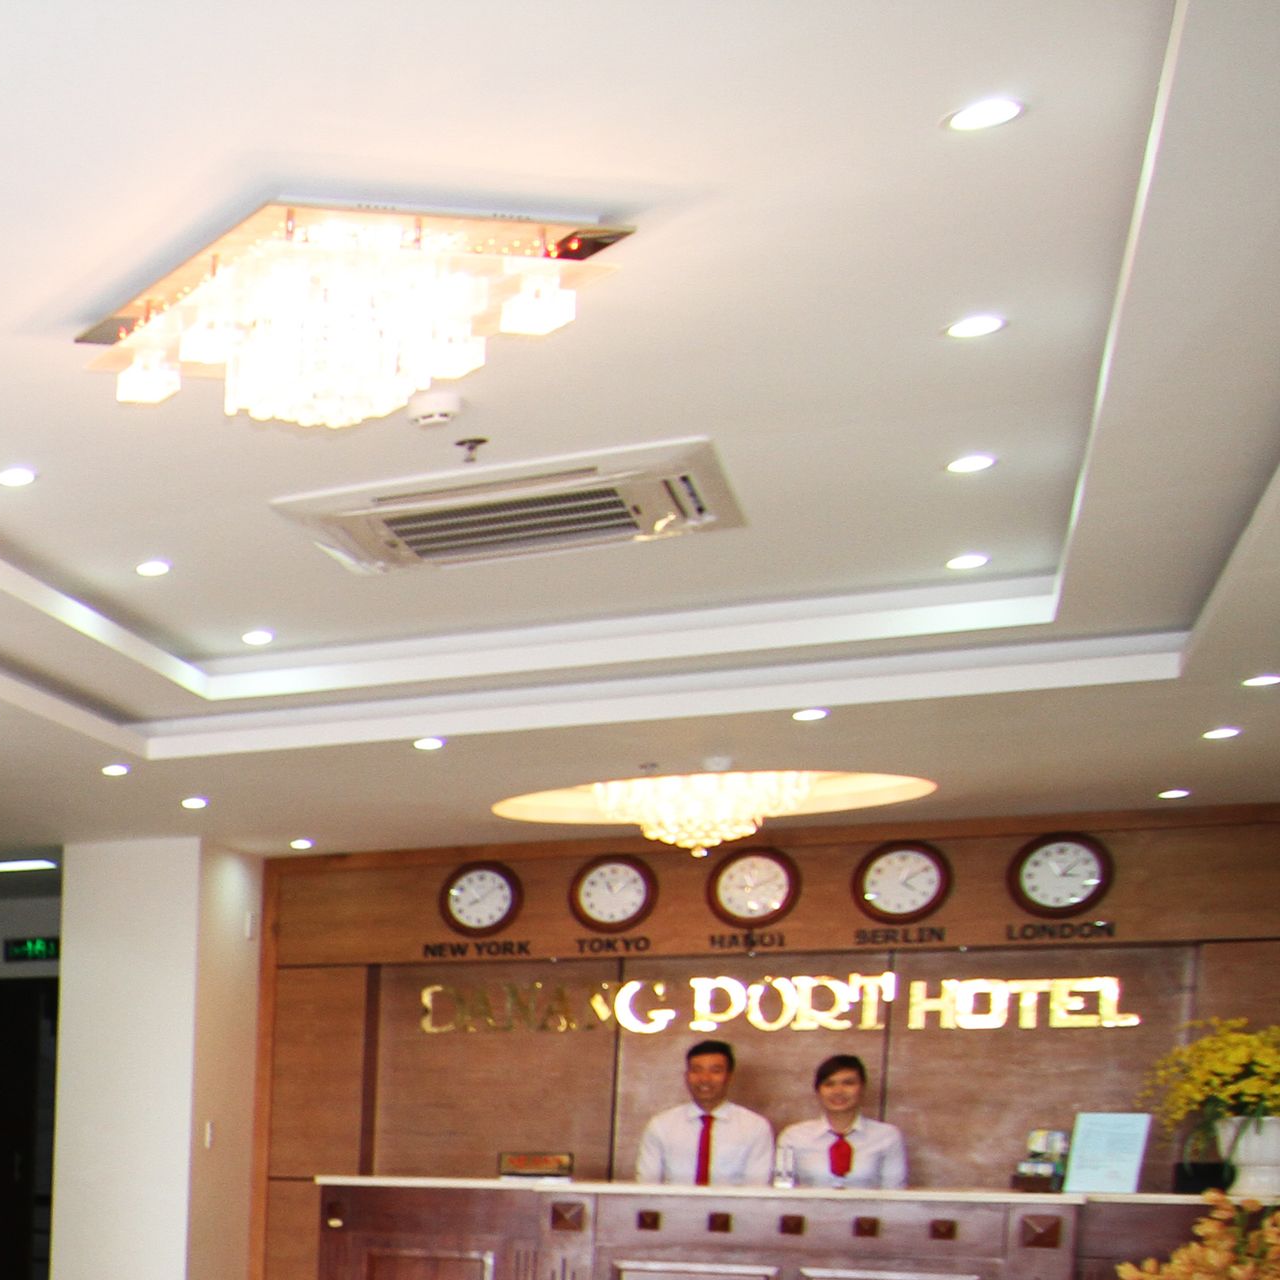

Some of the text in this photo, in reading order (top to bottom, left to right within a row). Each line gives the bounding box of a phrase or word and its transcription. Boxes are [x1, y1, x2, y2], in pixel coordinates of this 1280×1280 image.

[854, 926, 945, 945] BERLIN
[1005, 922, 1116, 941] LONDON
[423, 939, 531, 958] NEW YORK
[576, 937, 651, 953] TOKYO
[709, 934, 785, 950] HANOI
[689, 974, 896, 1032] PORT
[907, 976, 1140, 1030] HOTEL
